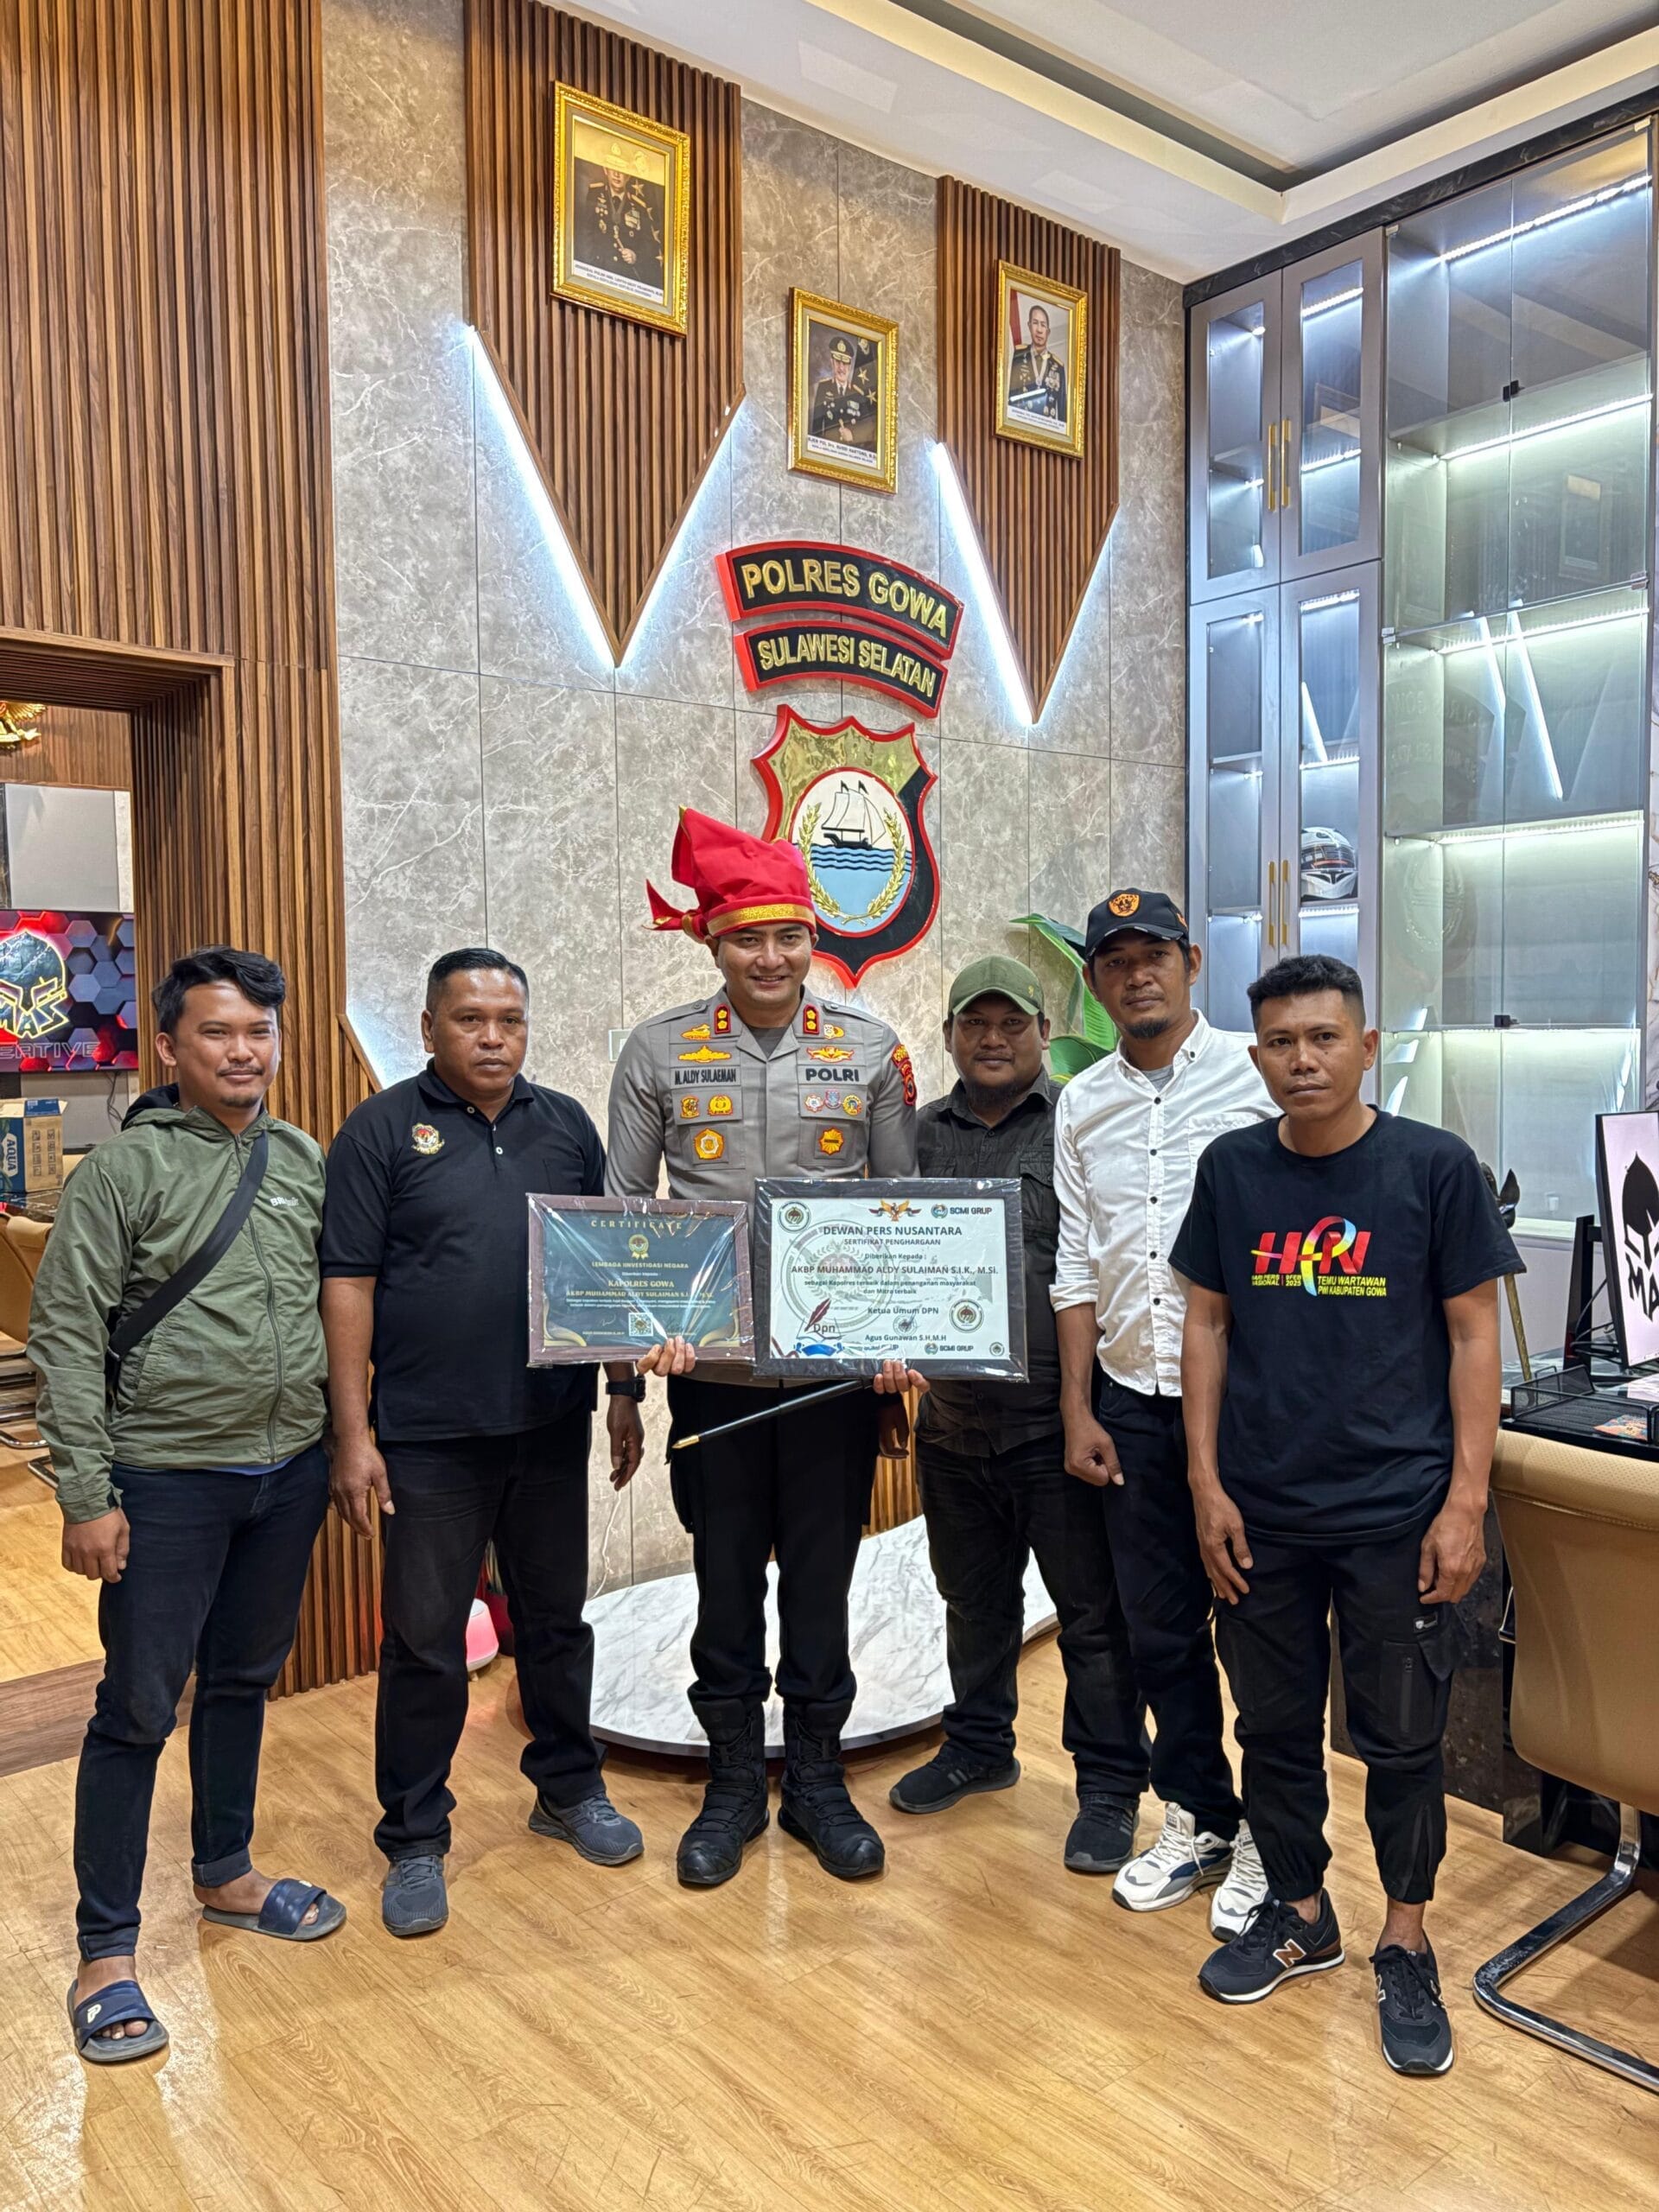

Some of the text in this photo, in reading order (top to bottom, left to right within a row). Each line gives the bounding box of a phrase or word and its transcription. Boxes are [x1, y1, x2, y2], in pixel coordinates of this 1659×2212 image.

[741, 558, 948, 638] POLRES GOWA
[758, 633, 937, 698] SULAWESI SELATAN
[701, 1068, 736, 1084] SULAEMAN
[805, 1068, 860, 1082] POLRI
[7, 1139, 17, 1172] AQUA
[949, 1206, 993, 1215] SCMI GRUP
[823, 1226, 963, 1236] DEWAN PERS NUSANTARA
[1317, 1275, 1386, 1287] TEMU WARTAWAN
[1329, 1286, 1365, 1296] KABUPATEN
[1366, 1287, 1387, 1297] GOWA
[813, 1323, 836, 1334] Dpn
